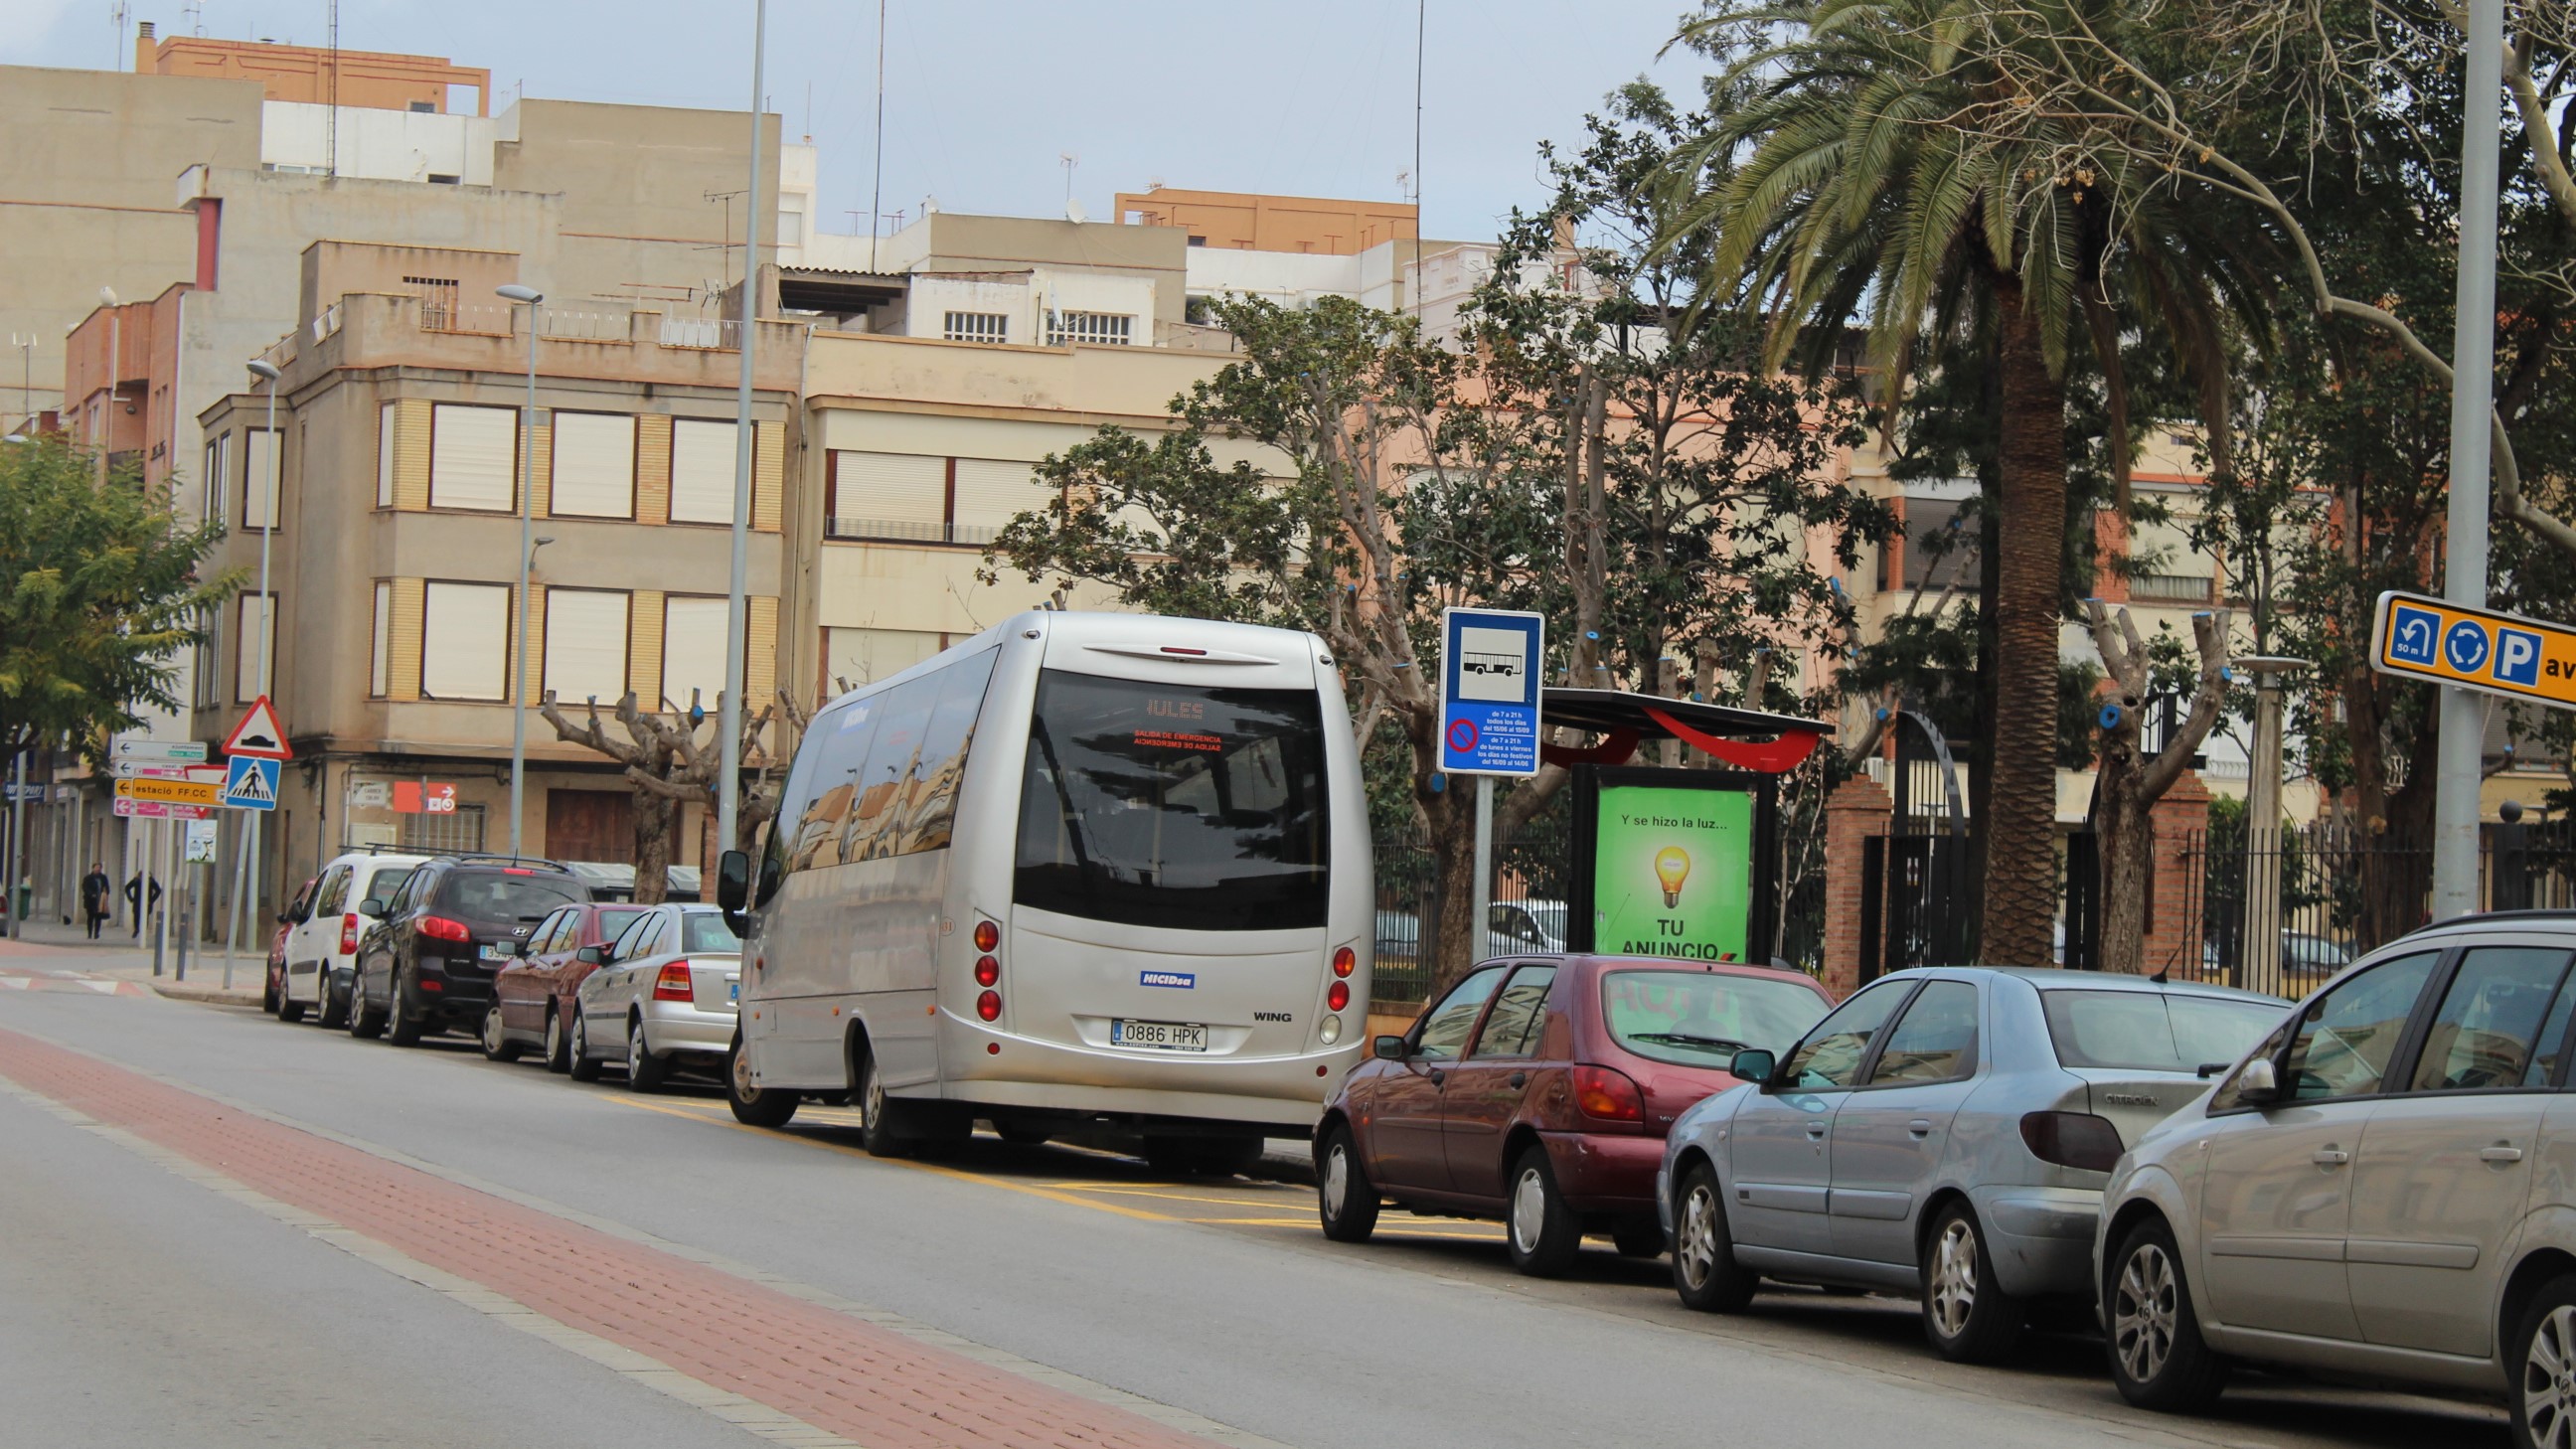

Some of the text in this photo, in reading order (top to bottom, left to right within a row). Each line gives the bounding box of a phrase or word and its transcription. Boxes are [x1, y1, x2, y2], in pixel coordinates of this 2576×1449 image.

[2397, 643, 2409, 653] 50
[2500, 634, 2533, 677] P
[1135, 729, 1161, 738] SALIDA
[1174, 732, 1221, 743] EMERGENCIA
[135, 785, 172, 795] estació
[1622, 814, 1630, 825] Y
[1634, 817, 1648, 826] se
[1652, 816, 1678, 827] hizo
[1683, 817, 1693, 828] la
[1657, 919, 1684, 936] TU
[1623, 940, 1718, 960] ANUNCIO
[1253, 1012, 1292, 1023] WING
[1126, 1025, 1201, 1045] 0886 HPK
